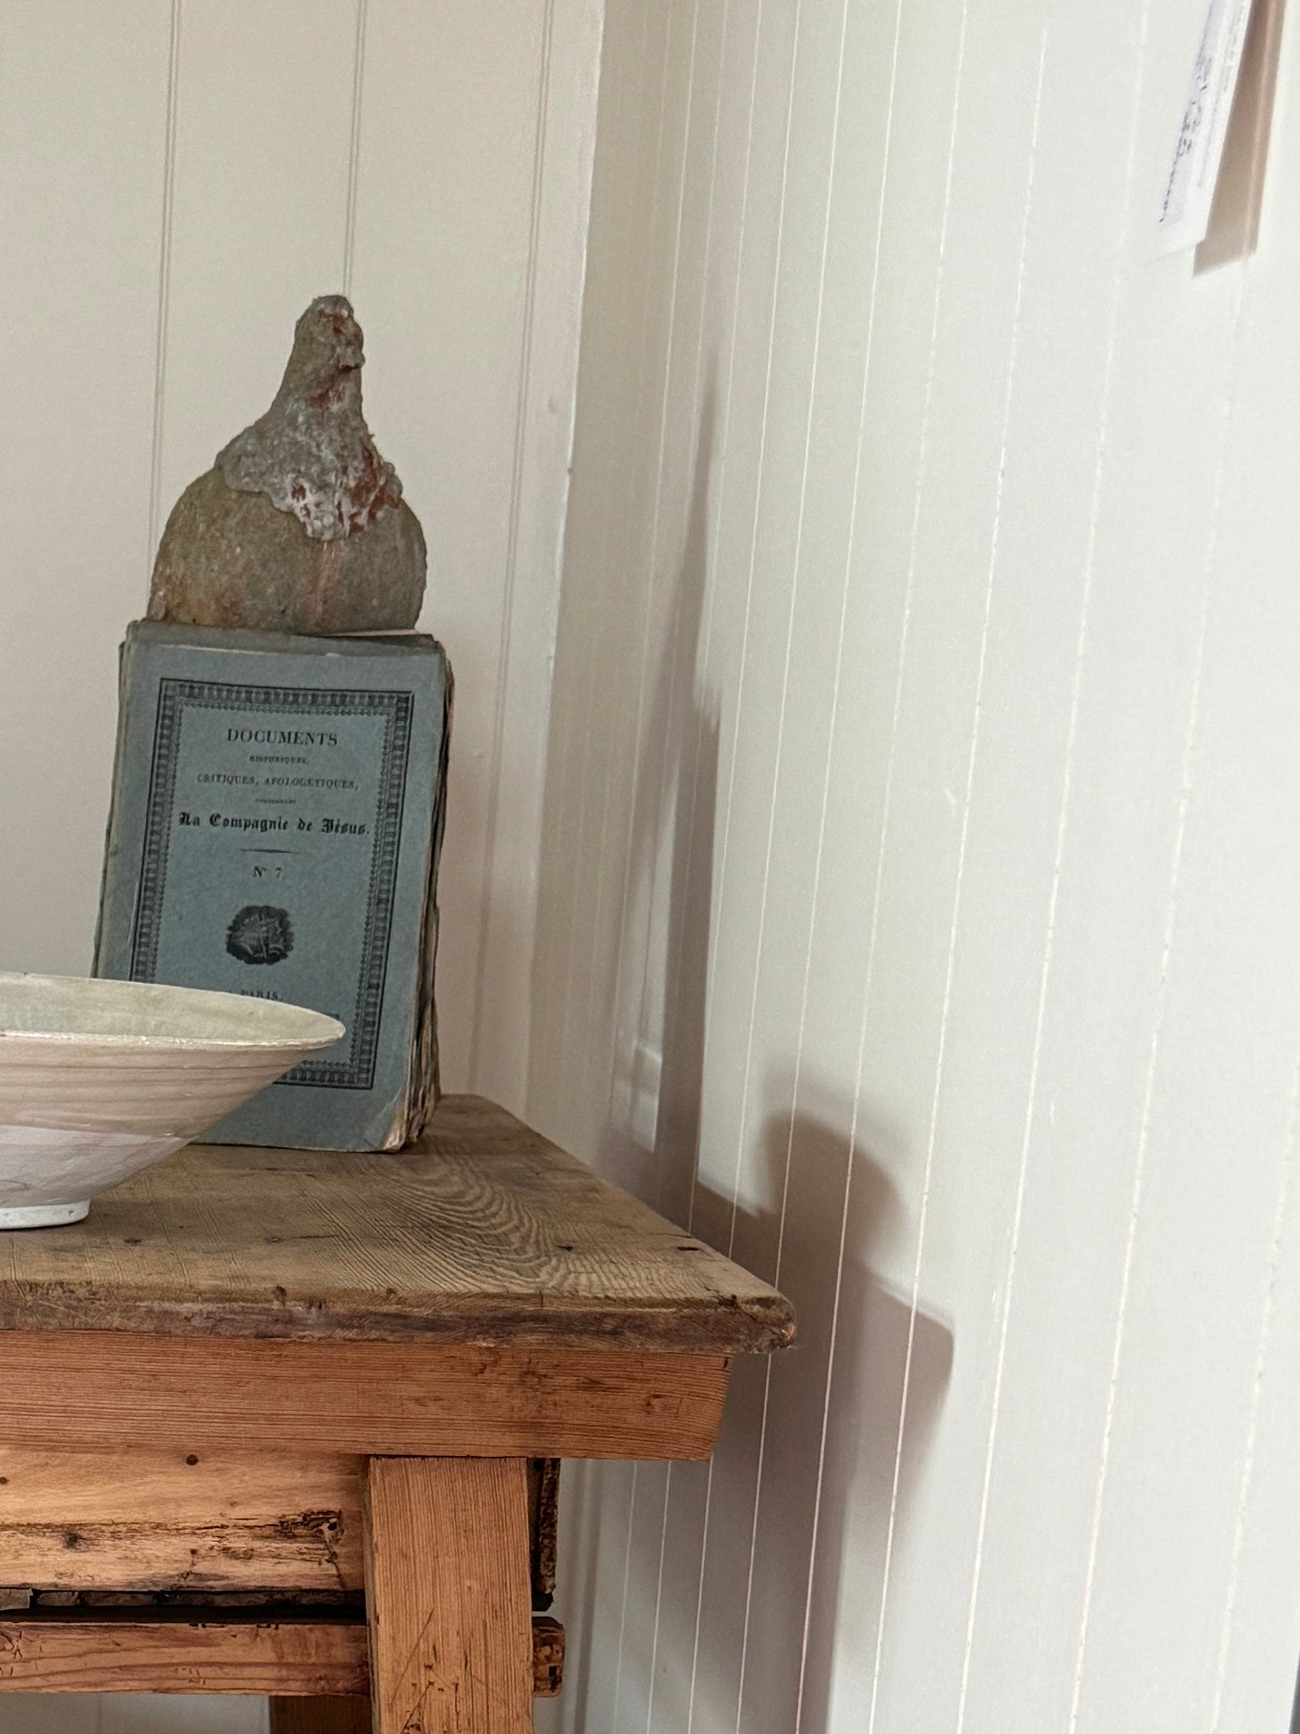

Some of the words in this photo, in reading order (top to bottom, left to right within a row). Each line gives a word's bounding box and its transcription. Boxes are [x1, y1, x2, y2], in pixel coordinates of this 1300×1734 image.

[227, 728, 338, 747] DOCUMENTS
[197, 773, 260, 787] CRITIQUES,
[209, 812, 289, 833] Compagnie
[297, 817, 312, 832] de
